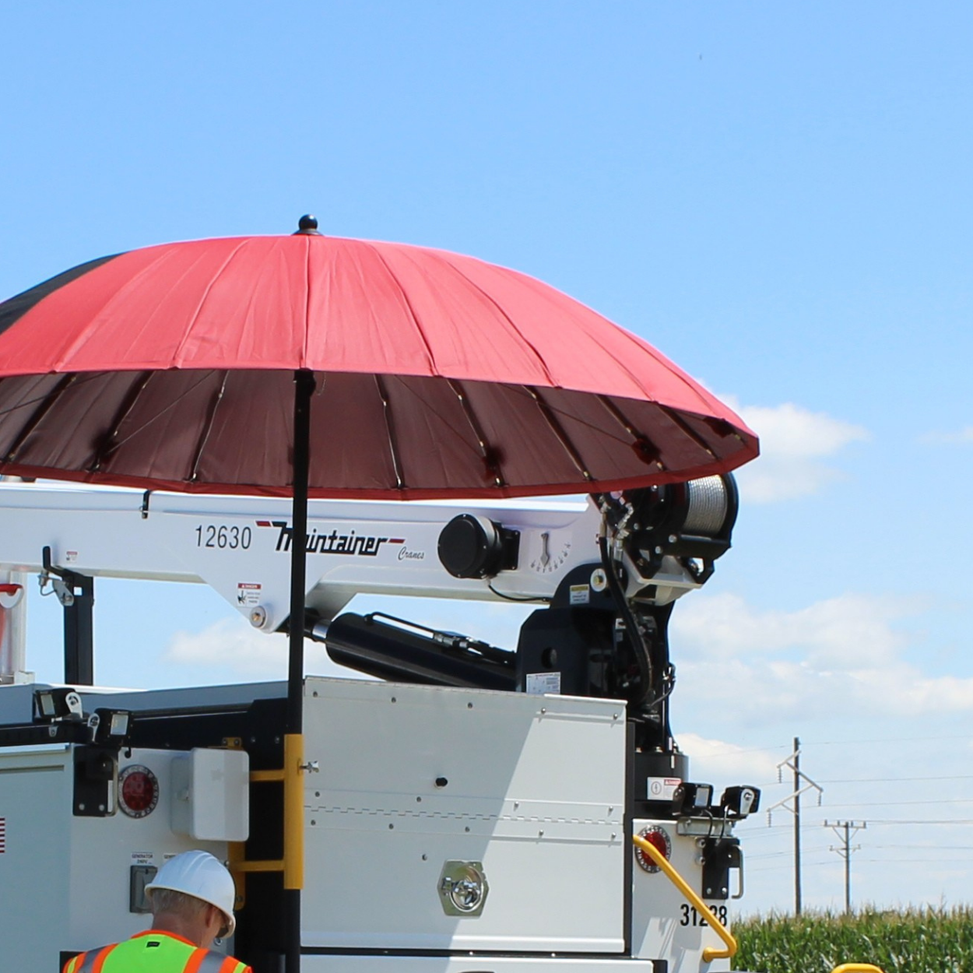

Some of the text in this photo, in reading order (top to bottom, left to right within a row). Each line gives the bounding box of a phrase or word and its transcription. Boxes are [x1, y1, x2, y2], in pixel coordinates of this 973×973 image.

[195, 525, 252, 549] 12630
[271, 521, 389, 556] Mintainer
[397, 546, 425, 560] Cranes
